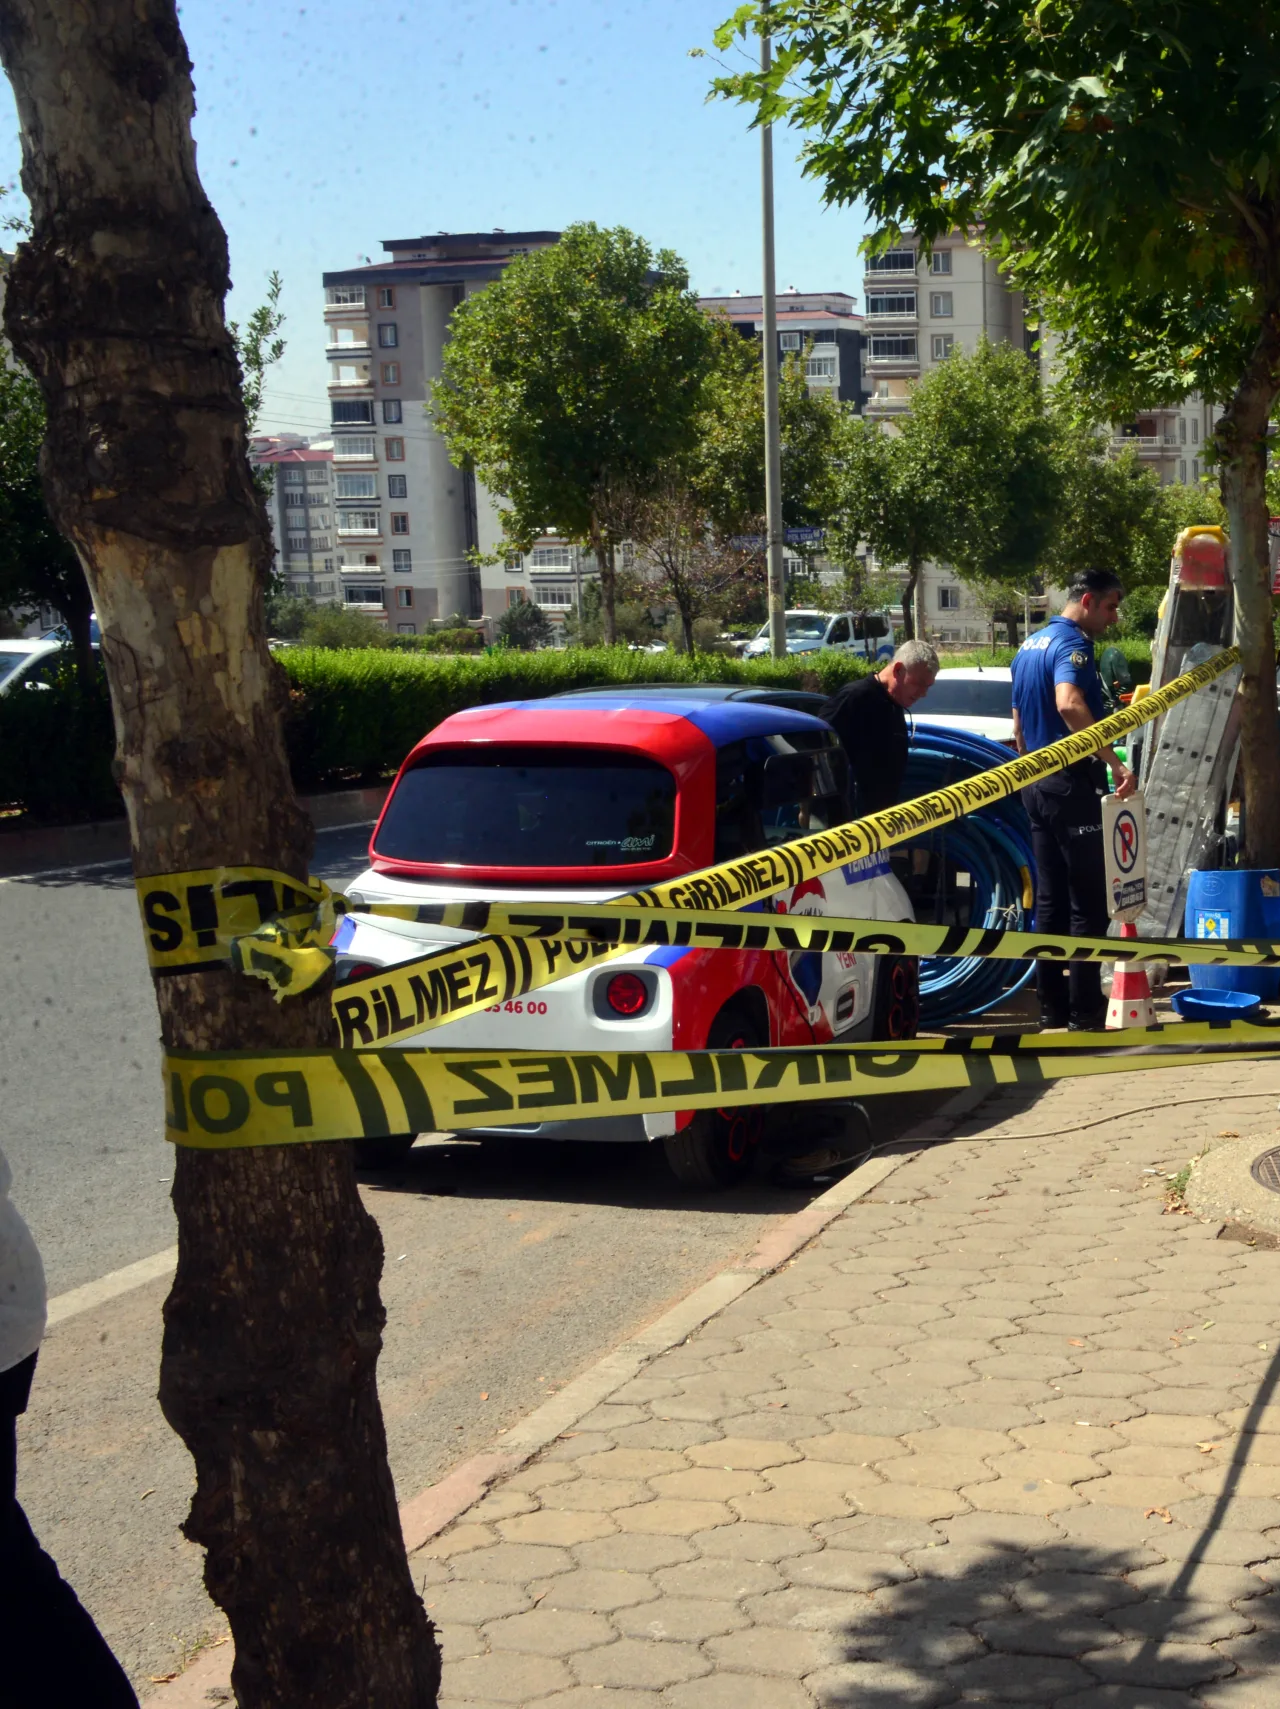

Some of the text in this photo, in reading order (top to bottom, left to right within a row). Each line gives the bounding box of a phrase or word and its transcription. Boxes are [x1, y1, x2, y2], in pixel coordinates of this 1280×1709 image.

[798, 829, 862, 869] POLİS
[875, 796, 952, 838] GİRİLMEZ
[957, 776, 1000, 804] POLİS
[334, 952, 499, 1047] RİLMEZ
[504, 1000, 523, 1014] 46
[527, 1001, 548, 1015] 00
